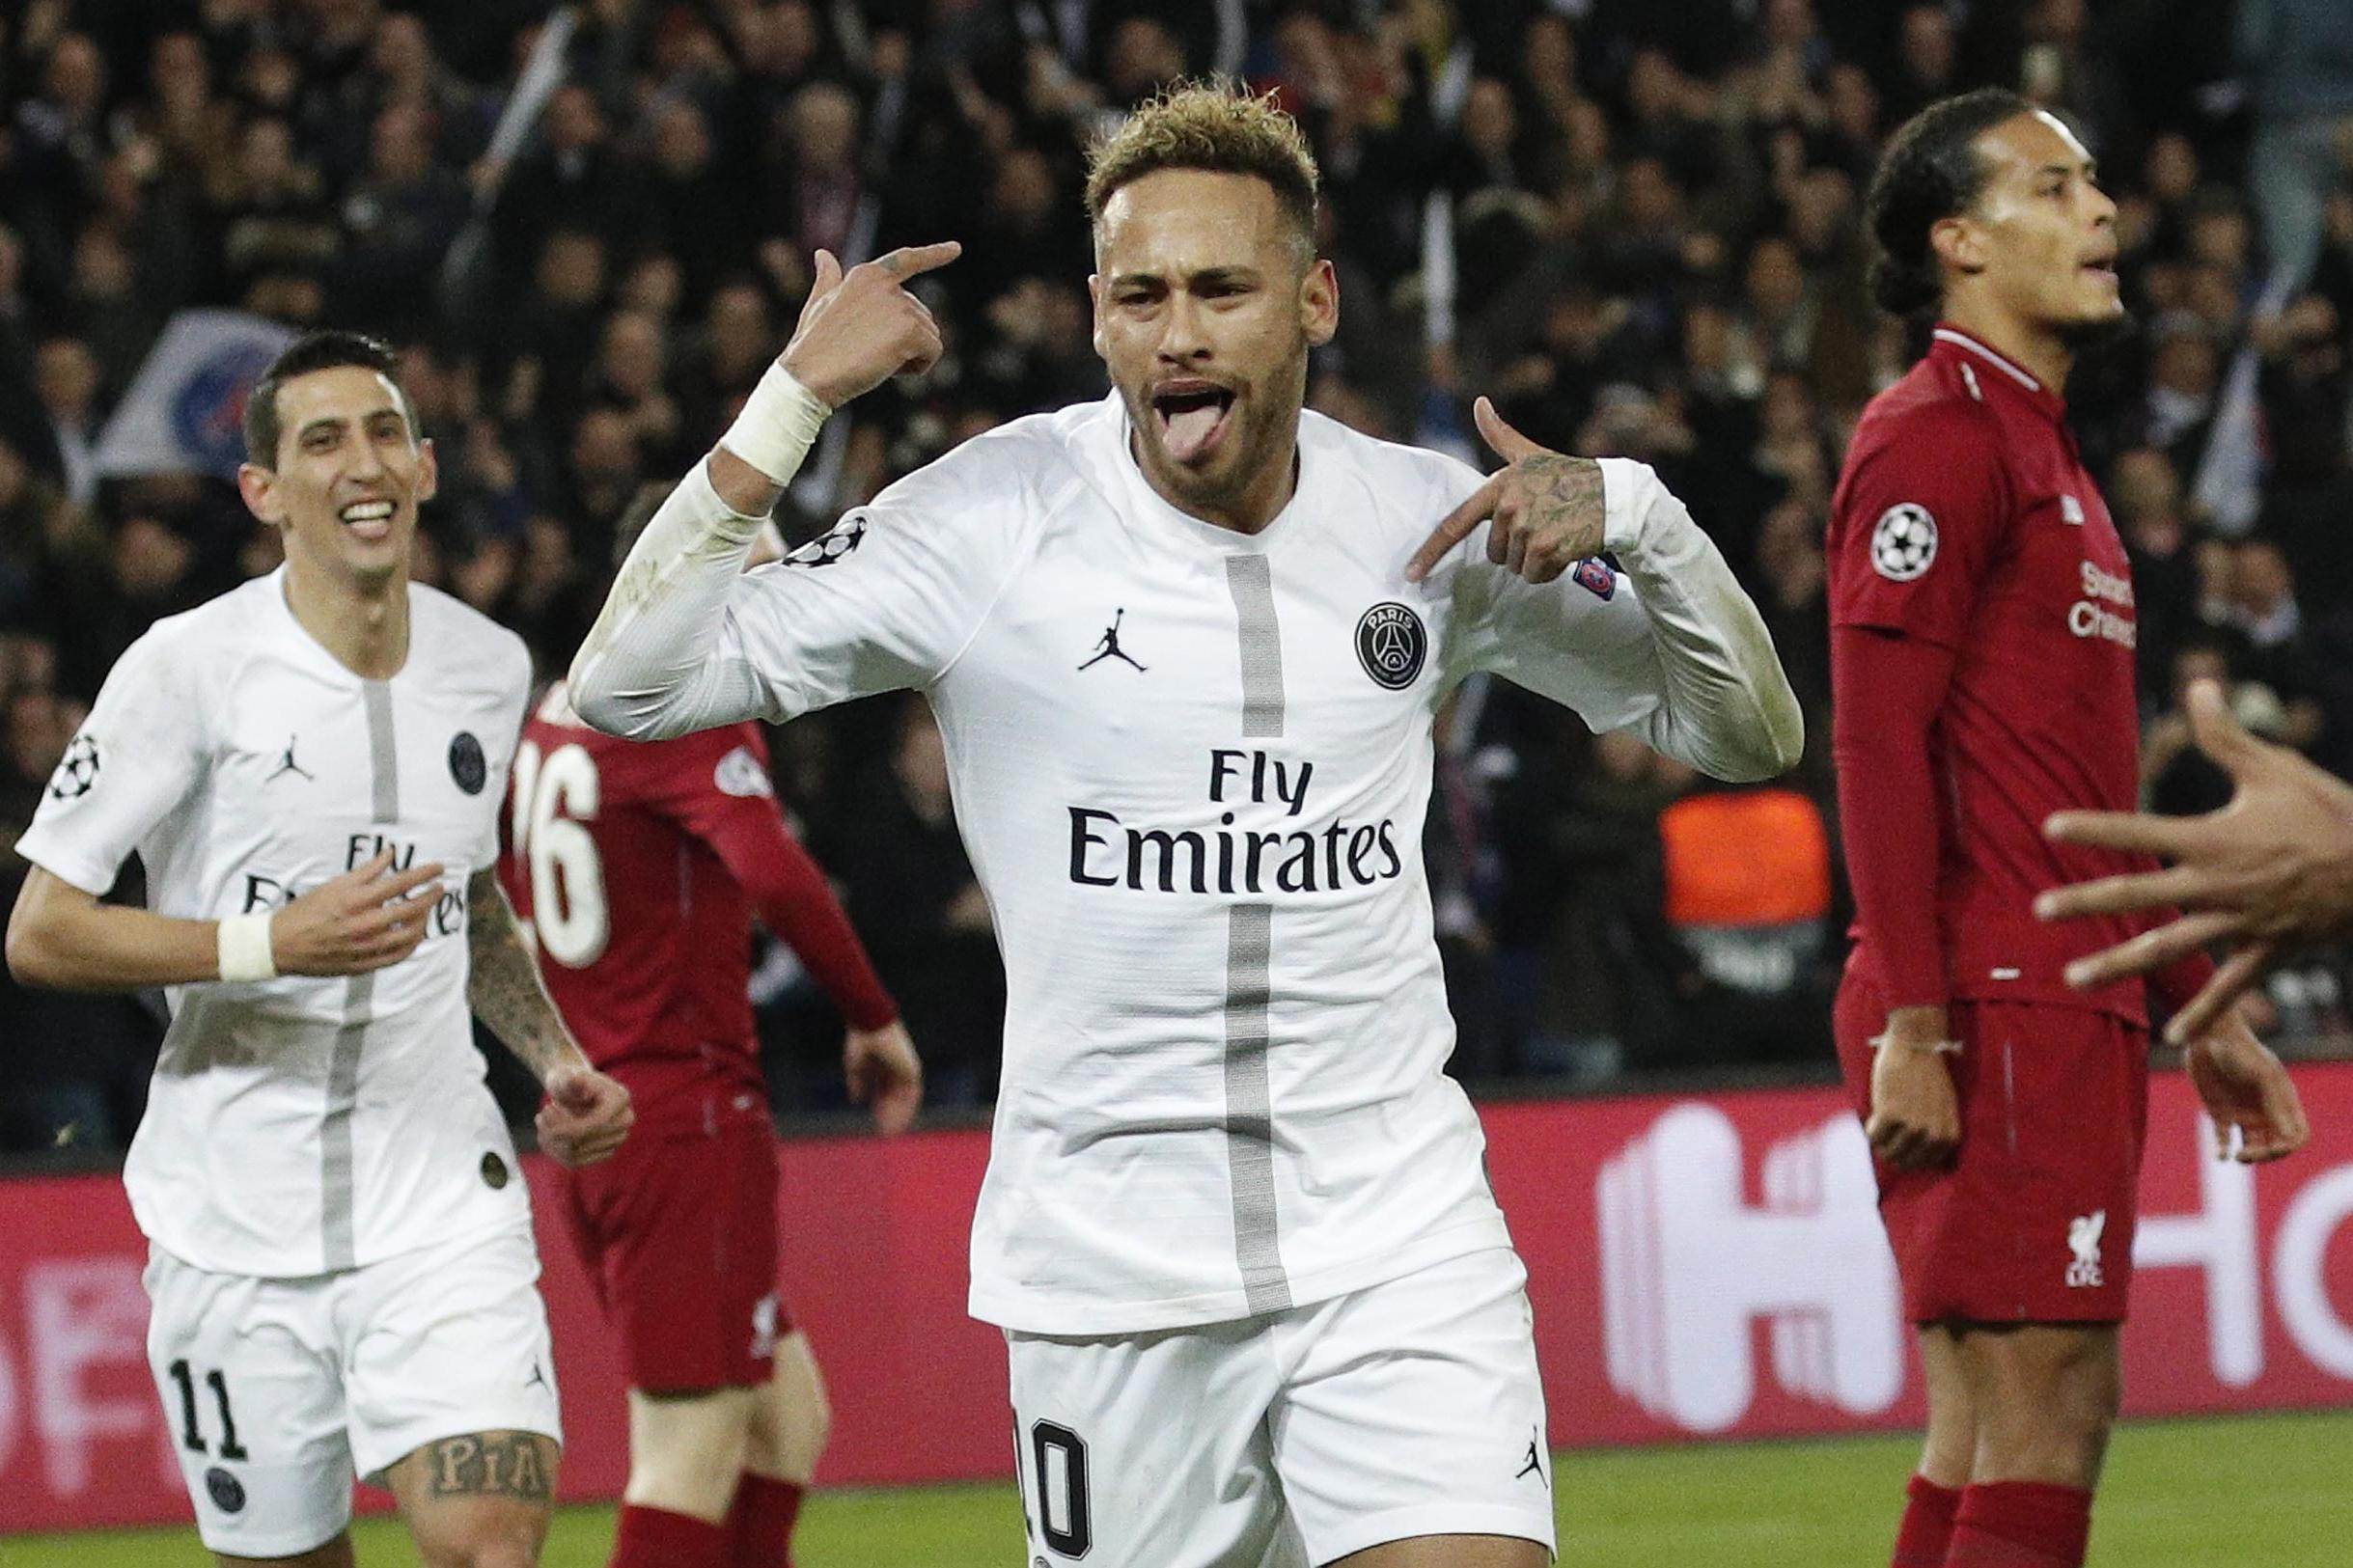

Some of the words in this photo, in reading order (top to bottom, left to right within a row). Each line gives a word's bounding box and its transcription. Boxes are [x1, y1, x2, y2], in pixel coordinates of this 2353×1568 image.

[1367, 609, 1414, 629] PARIS
[1209, 750, 1314, 816] Fly
[1067, 807, 1401, 894] Emirates
[169, 1359, 248, 1462] 11
